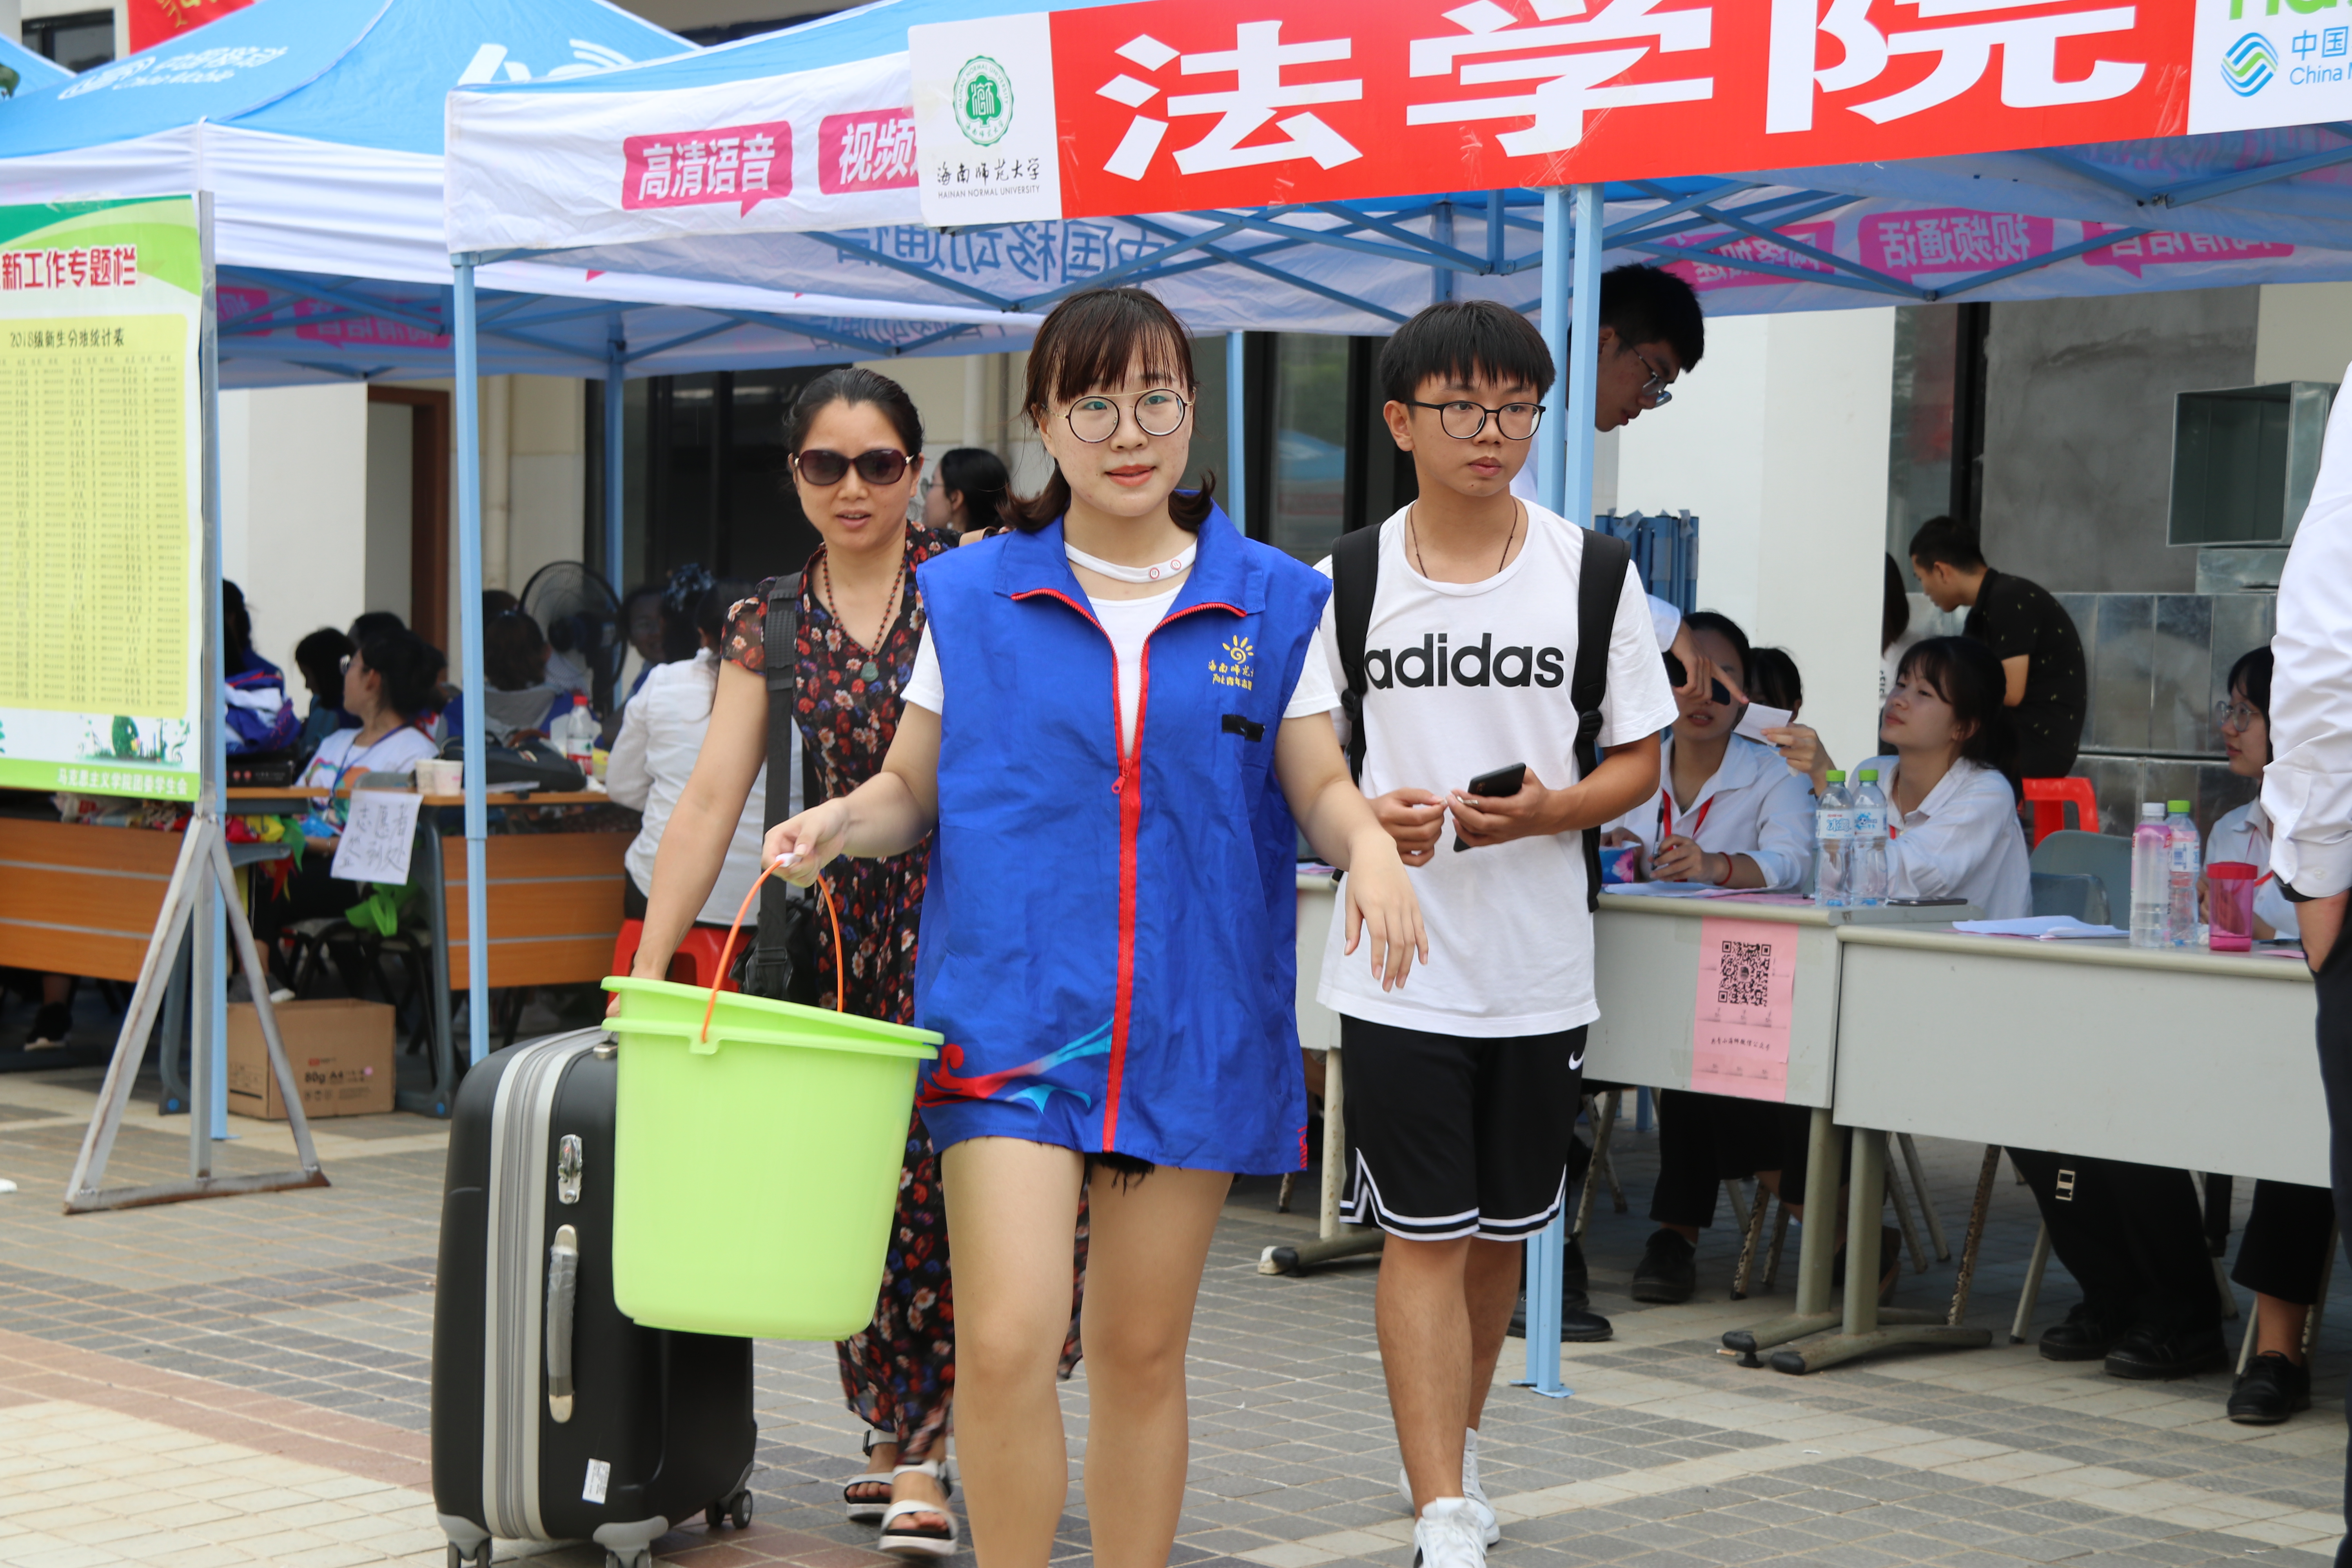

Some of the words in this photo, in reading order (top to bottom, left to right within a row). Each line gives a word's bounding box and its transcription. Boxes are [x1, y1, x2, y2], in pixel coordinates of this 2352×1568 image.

[2292, 25, 2352, 61] 中国
[965, 64, 988, 78] NORMAL
[989, 65, 1009, 105] UNIVERSITY
[1095, 0, 2146, 181] 法学院
[2290, 64, 2342, 85] China
[637, 132, 776, 201] 高清语音
[838, 117, 919, 185] 视频
[937, 157, 1040, 186] 海南师范大学
[938, 190, 965, 200] HAINAN
[968, 187, 998, 197] NORMAL
[1000, 185, 1040, 196] UNIVERSITY
[0, 247, 136, 290] 新工作专题栏
[1363, 632, 1564, 690] adidas
